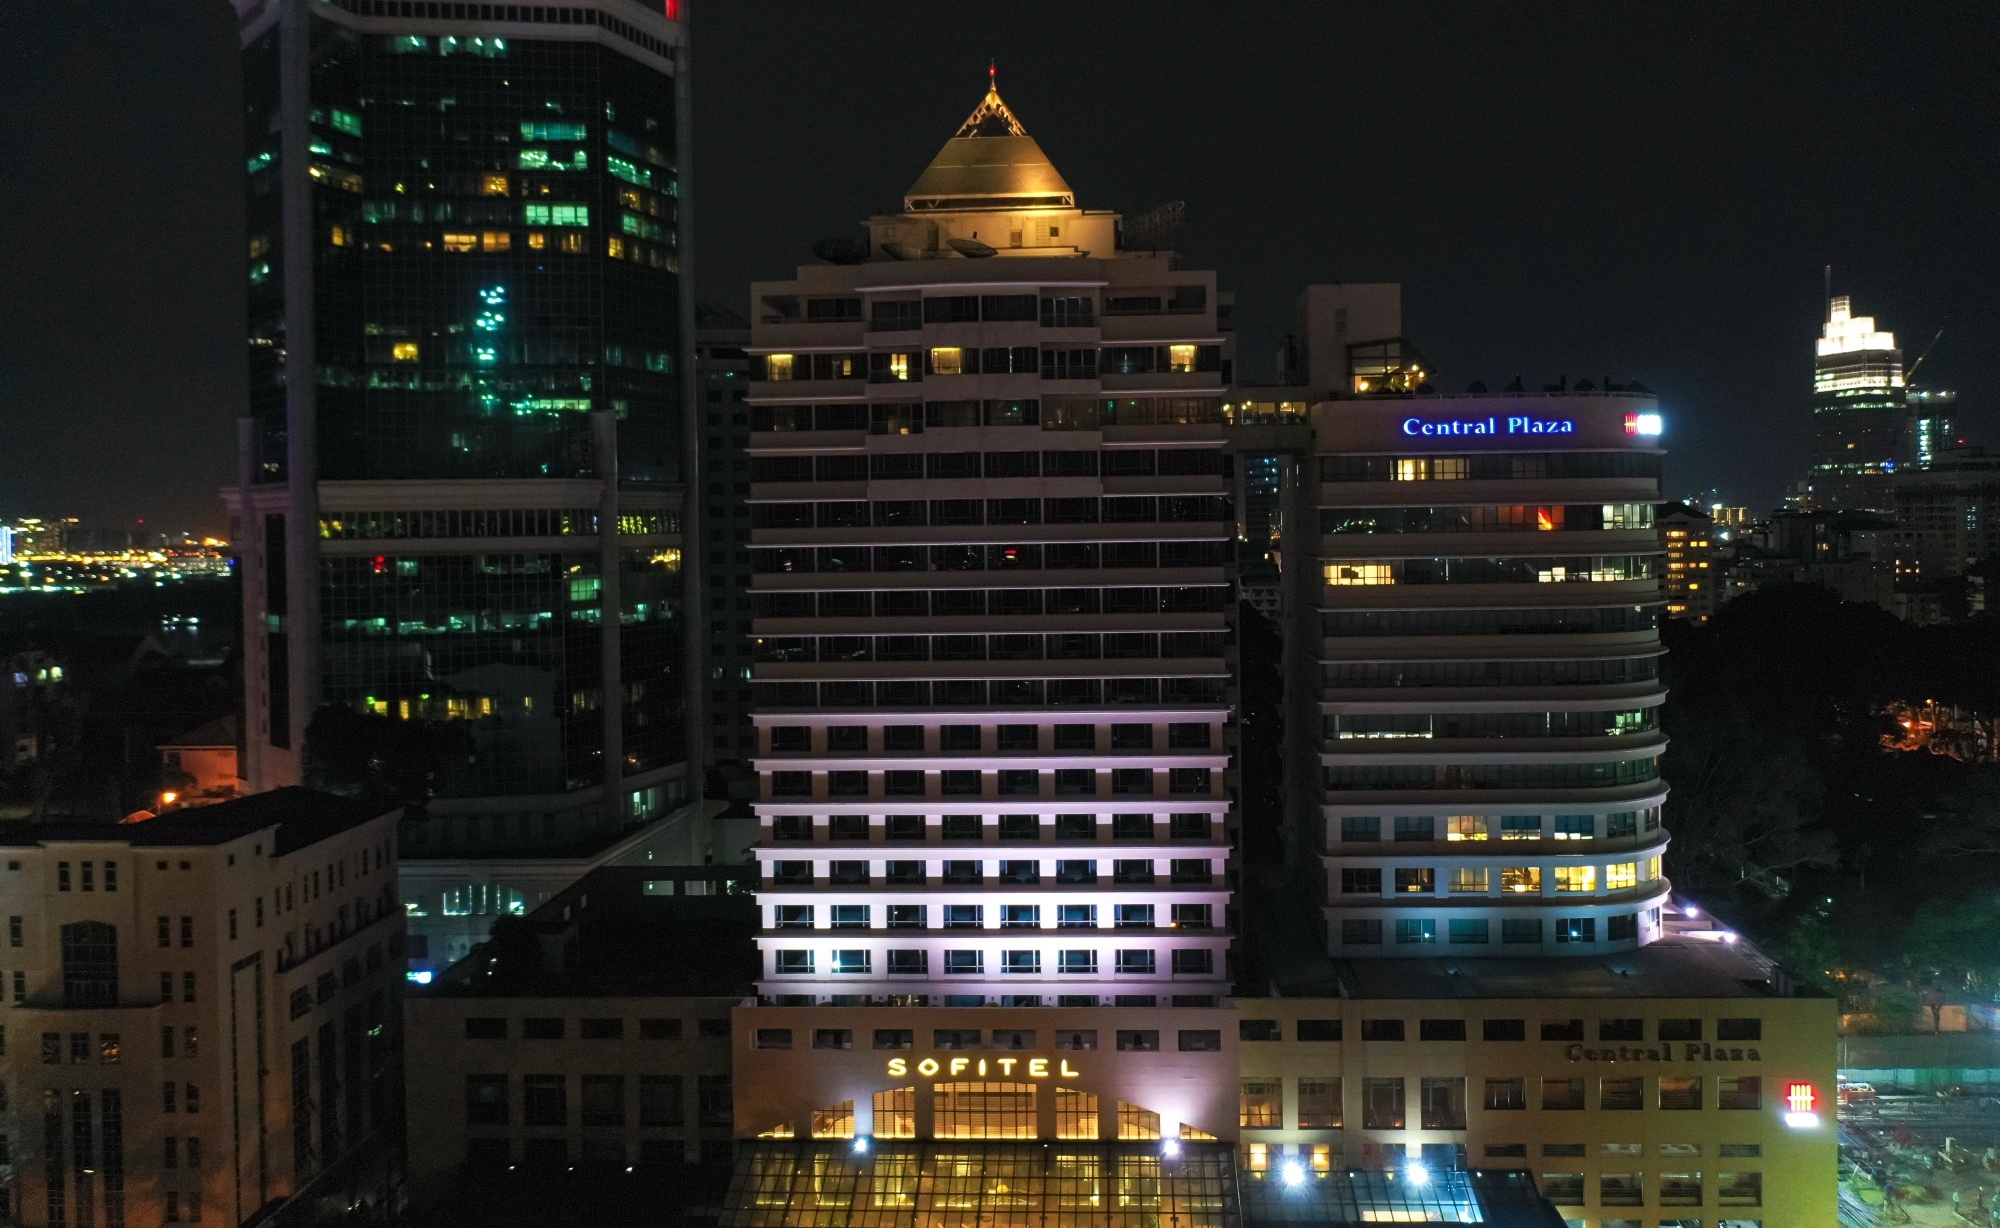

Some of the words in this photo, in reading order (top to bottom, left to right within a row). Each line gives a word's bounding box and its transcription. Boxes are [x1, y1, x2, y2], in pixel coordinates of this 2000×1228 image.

[1402, 417, 1496, 435] Central
[1508, 416, 1573, 434] Plaza
[1567, 1043, 1672, 1062] Central
[1685, 1043, 1762, 1062] Plaza
[888, 1058, 1079, 1077] SOFITEL
